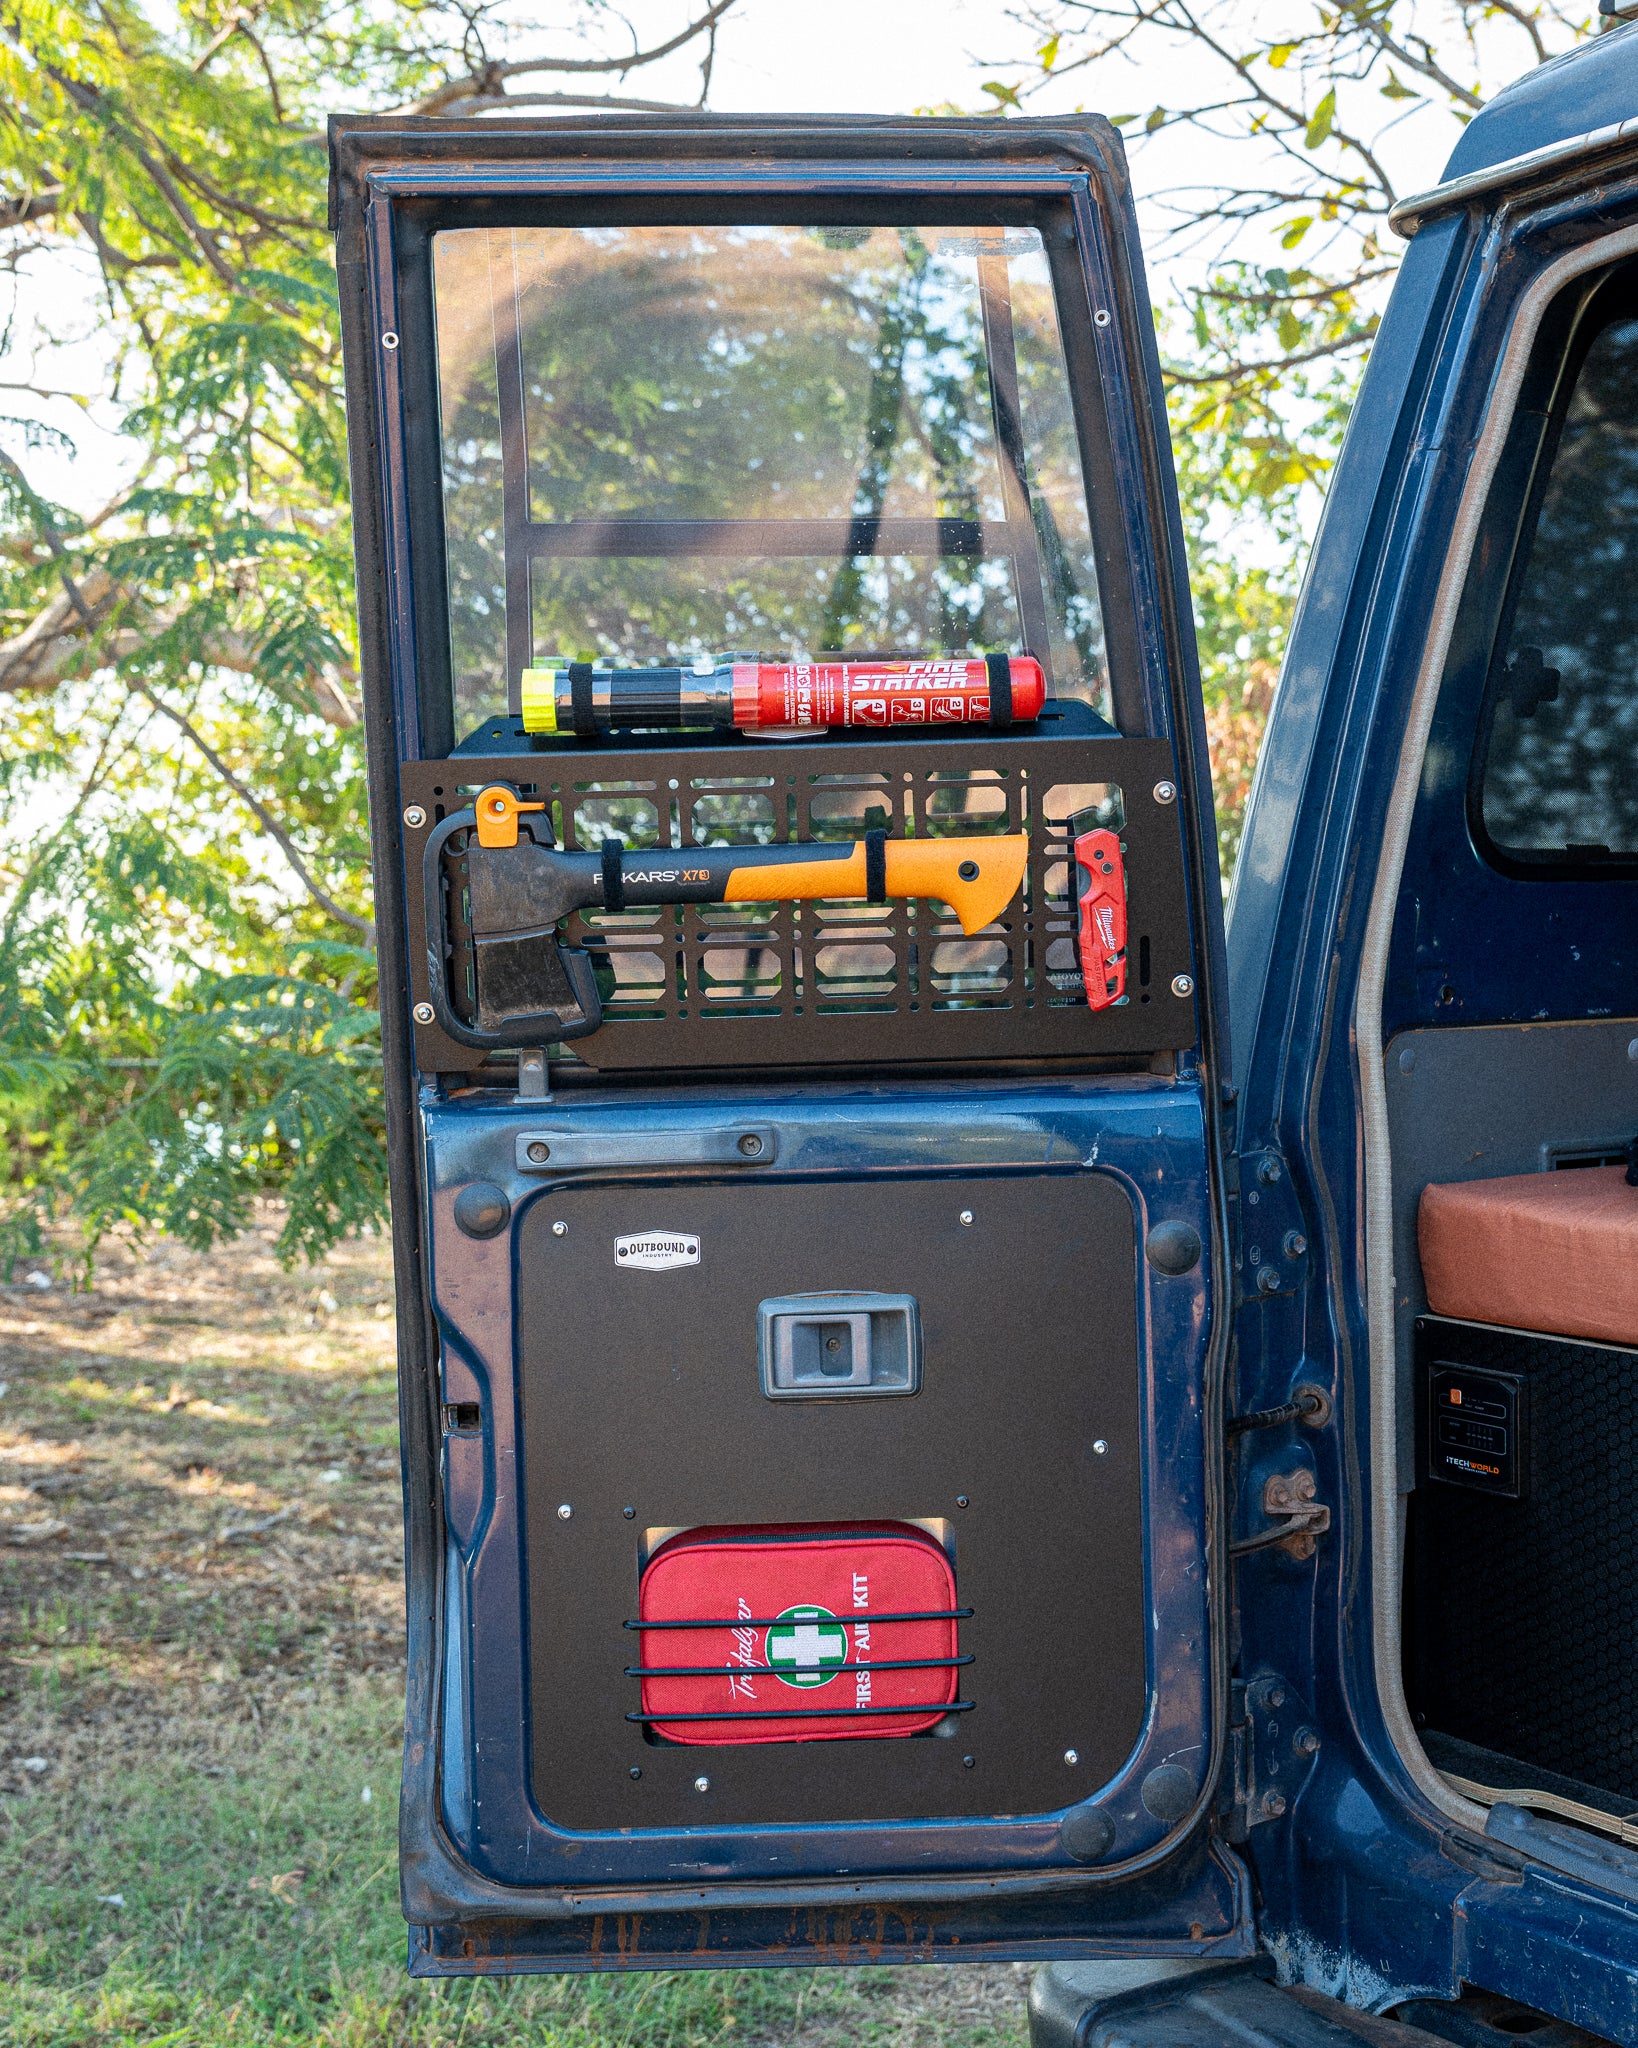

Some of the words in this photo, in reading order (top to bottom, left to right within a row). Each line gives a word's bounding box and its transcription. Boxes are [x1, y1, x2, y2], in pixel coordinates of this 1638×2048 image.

[908, 661, 969, 673] FIRE
[851, 673, 969, 692] STRYKER
[593, 871, 675, 885] FKARS
[1099, 905, 1117, 950] Milwaukee
[629, 1242, 685, 1255] OUTBOUND
[852, 1572, 869, 1608] KIT
